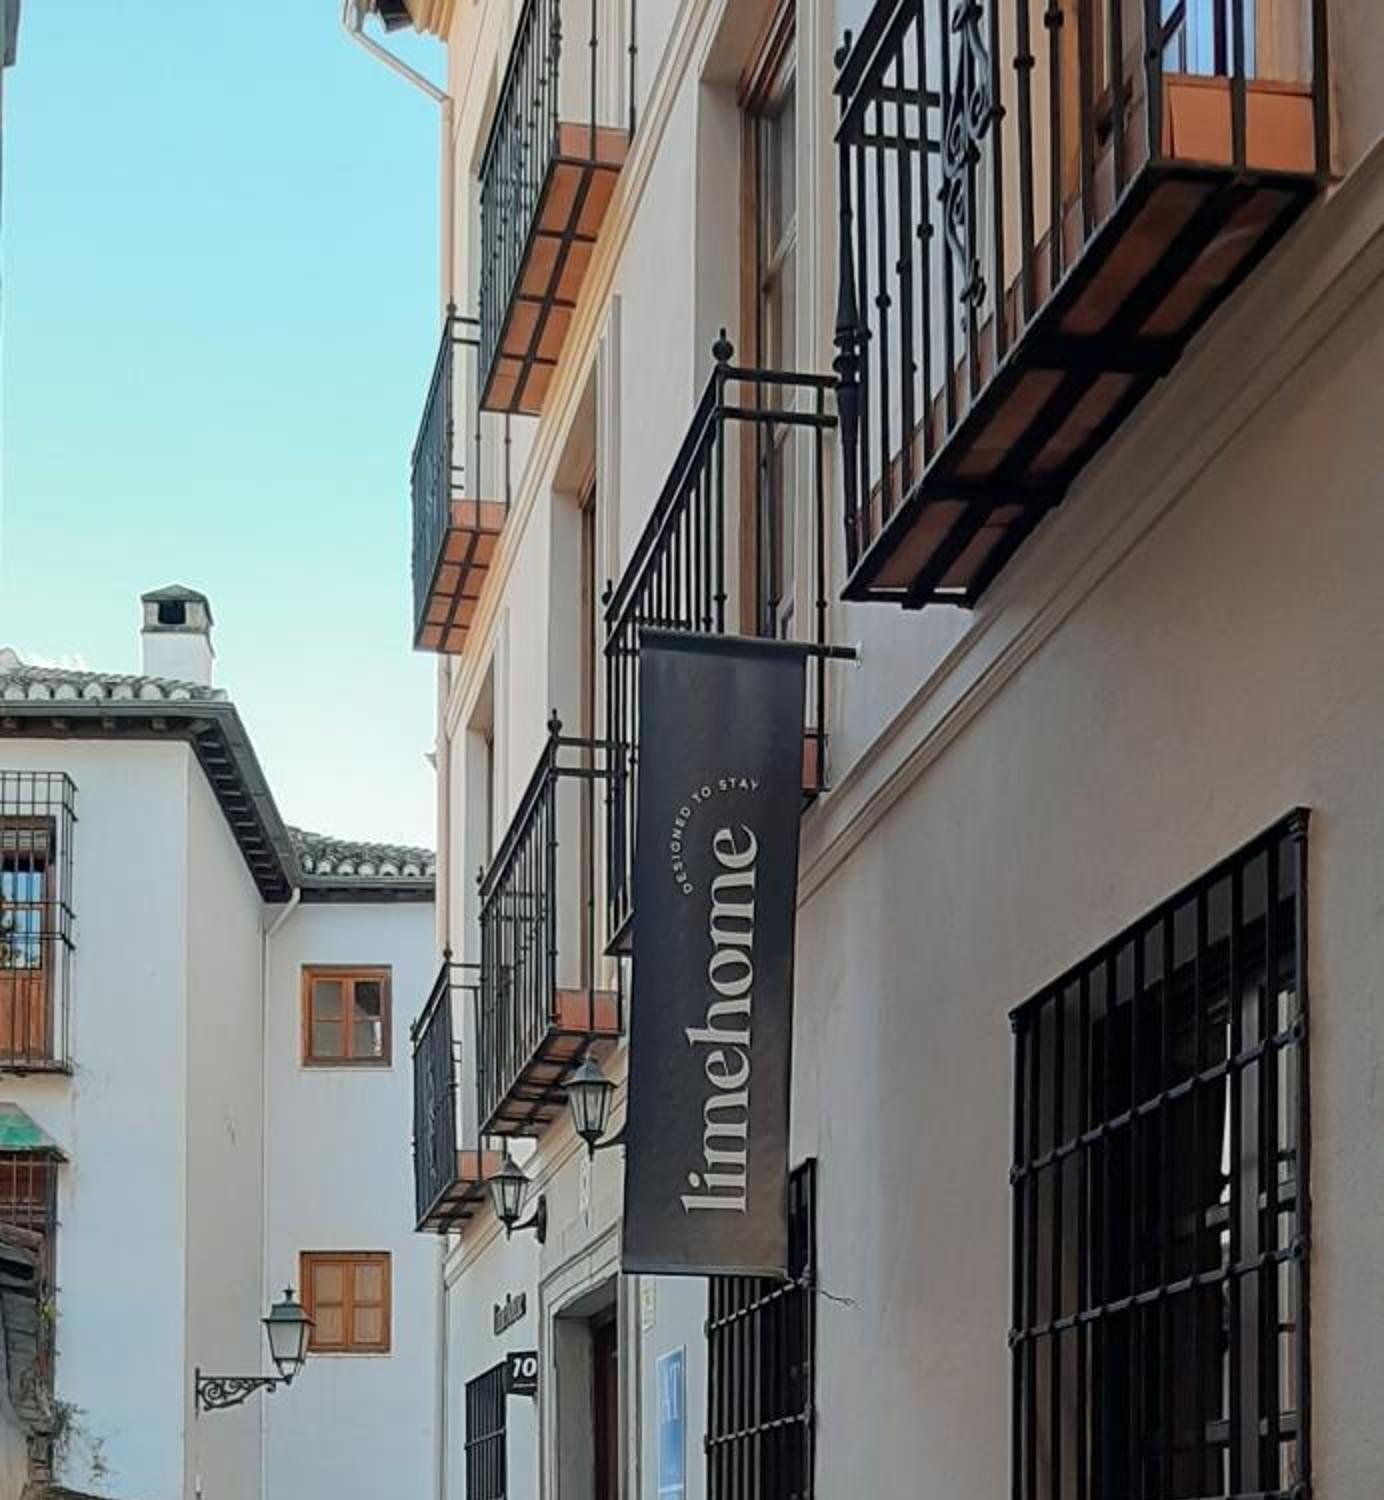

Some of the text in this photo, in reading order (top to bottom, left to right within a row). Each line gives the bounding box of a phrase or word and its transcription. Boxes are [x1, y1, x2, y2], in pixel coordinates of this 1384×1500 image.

[671, 778, 758, 894] DESIGNED TO STAY
[681, 823, 759, 1214] limehome
[513, 1357, 537, 1378] 10
